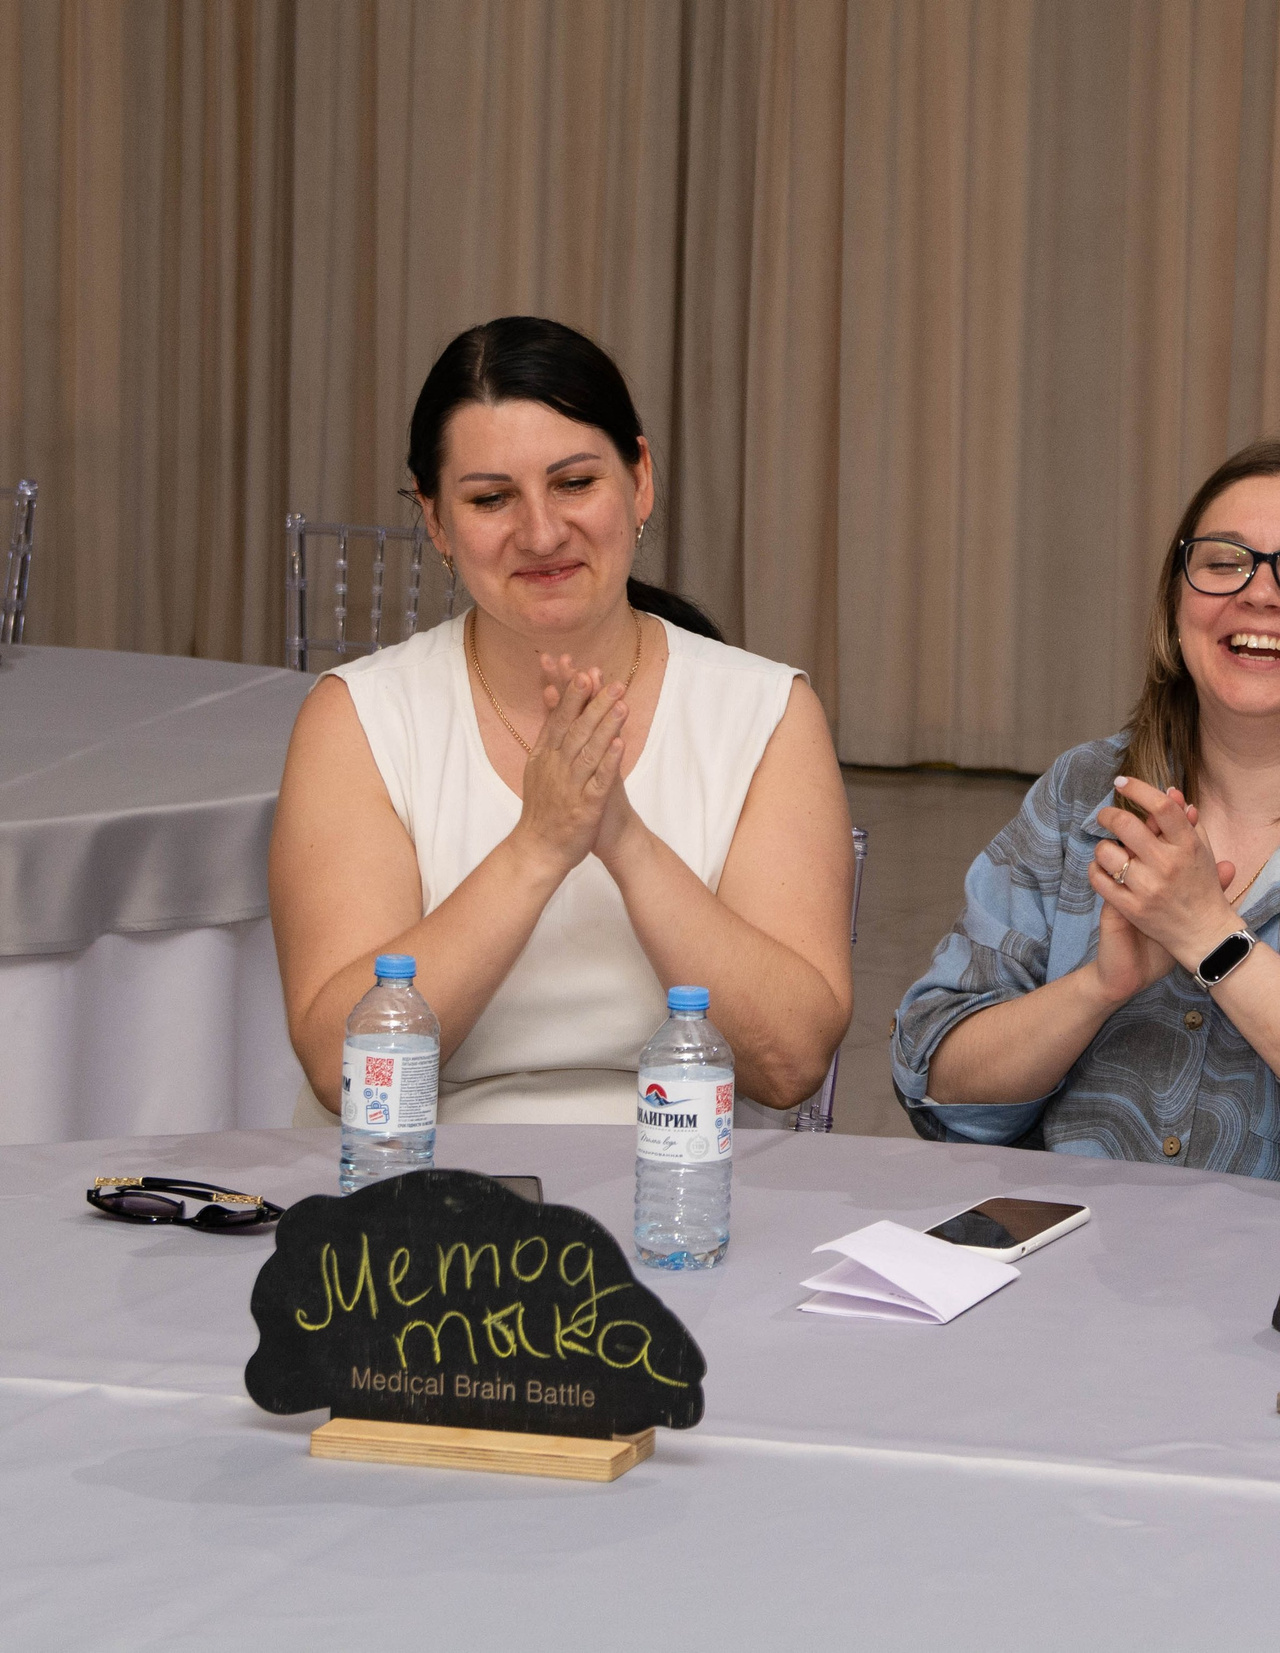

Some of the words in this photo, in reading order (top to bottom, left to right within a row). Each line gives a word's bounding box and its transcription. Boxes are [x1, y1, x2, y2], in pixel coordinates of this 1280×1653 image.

[637, 1106, 698, 1129] ИЛИГРИМ
[352, 1366, 444, 1396] Medical
[455, 1374, 516, 1402] Brain
[526, 1380, 596, 1408] Battle
